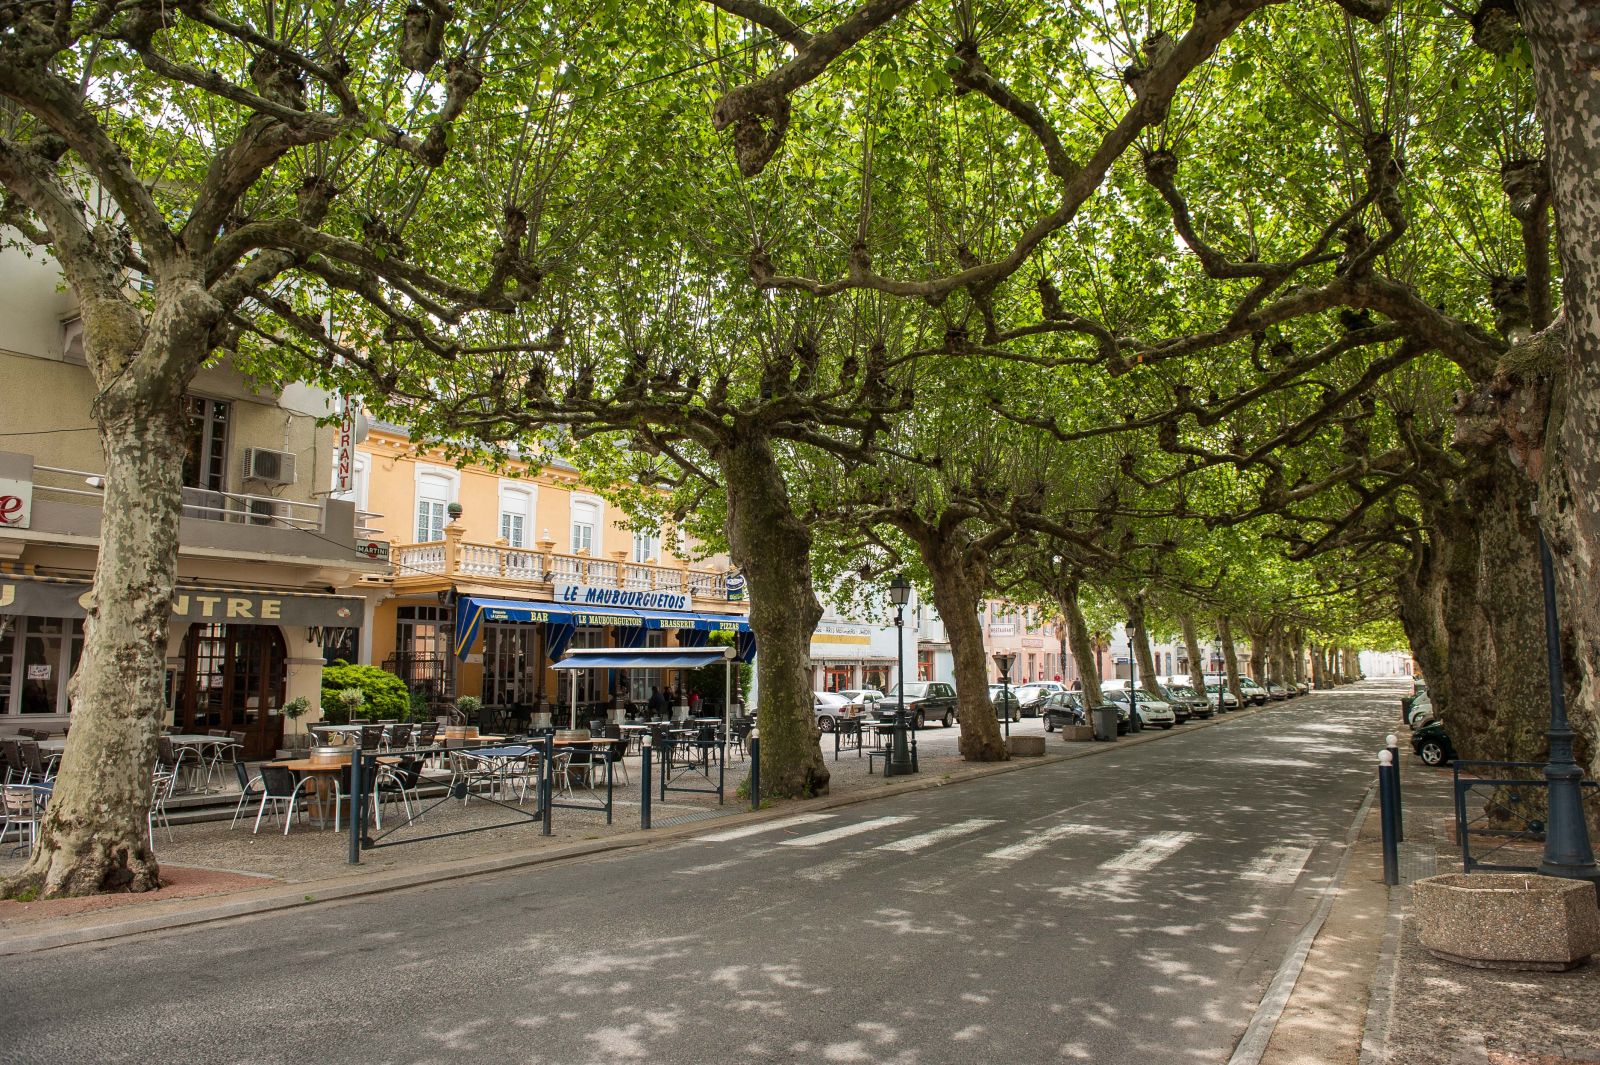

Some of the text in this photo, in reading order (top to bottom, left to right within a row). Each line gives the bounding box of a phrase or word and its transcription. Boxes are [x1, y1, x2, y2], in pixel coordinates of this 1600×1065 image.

[358, 546, 387, 555] MARTINI
[563, 585, 686, 609] LE MAUBOURGUETOIS
[530, 612, 549, 621] BAR
[578, 615, 642, 626] LE MAUBOURGUETOIS
[660, 620, 696, 629] BRASSERIE
[719, 622, 740, 630] PIZZAS
